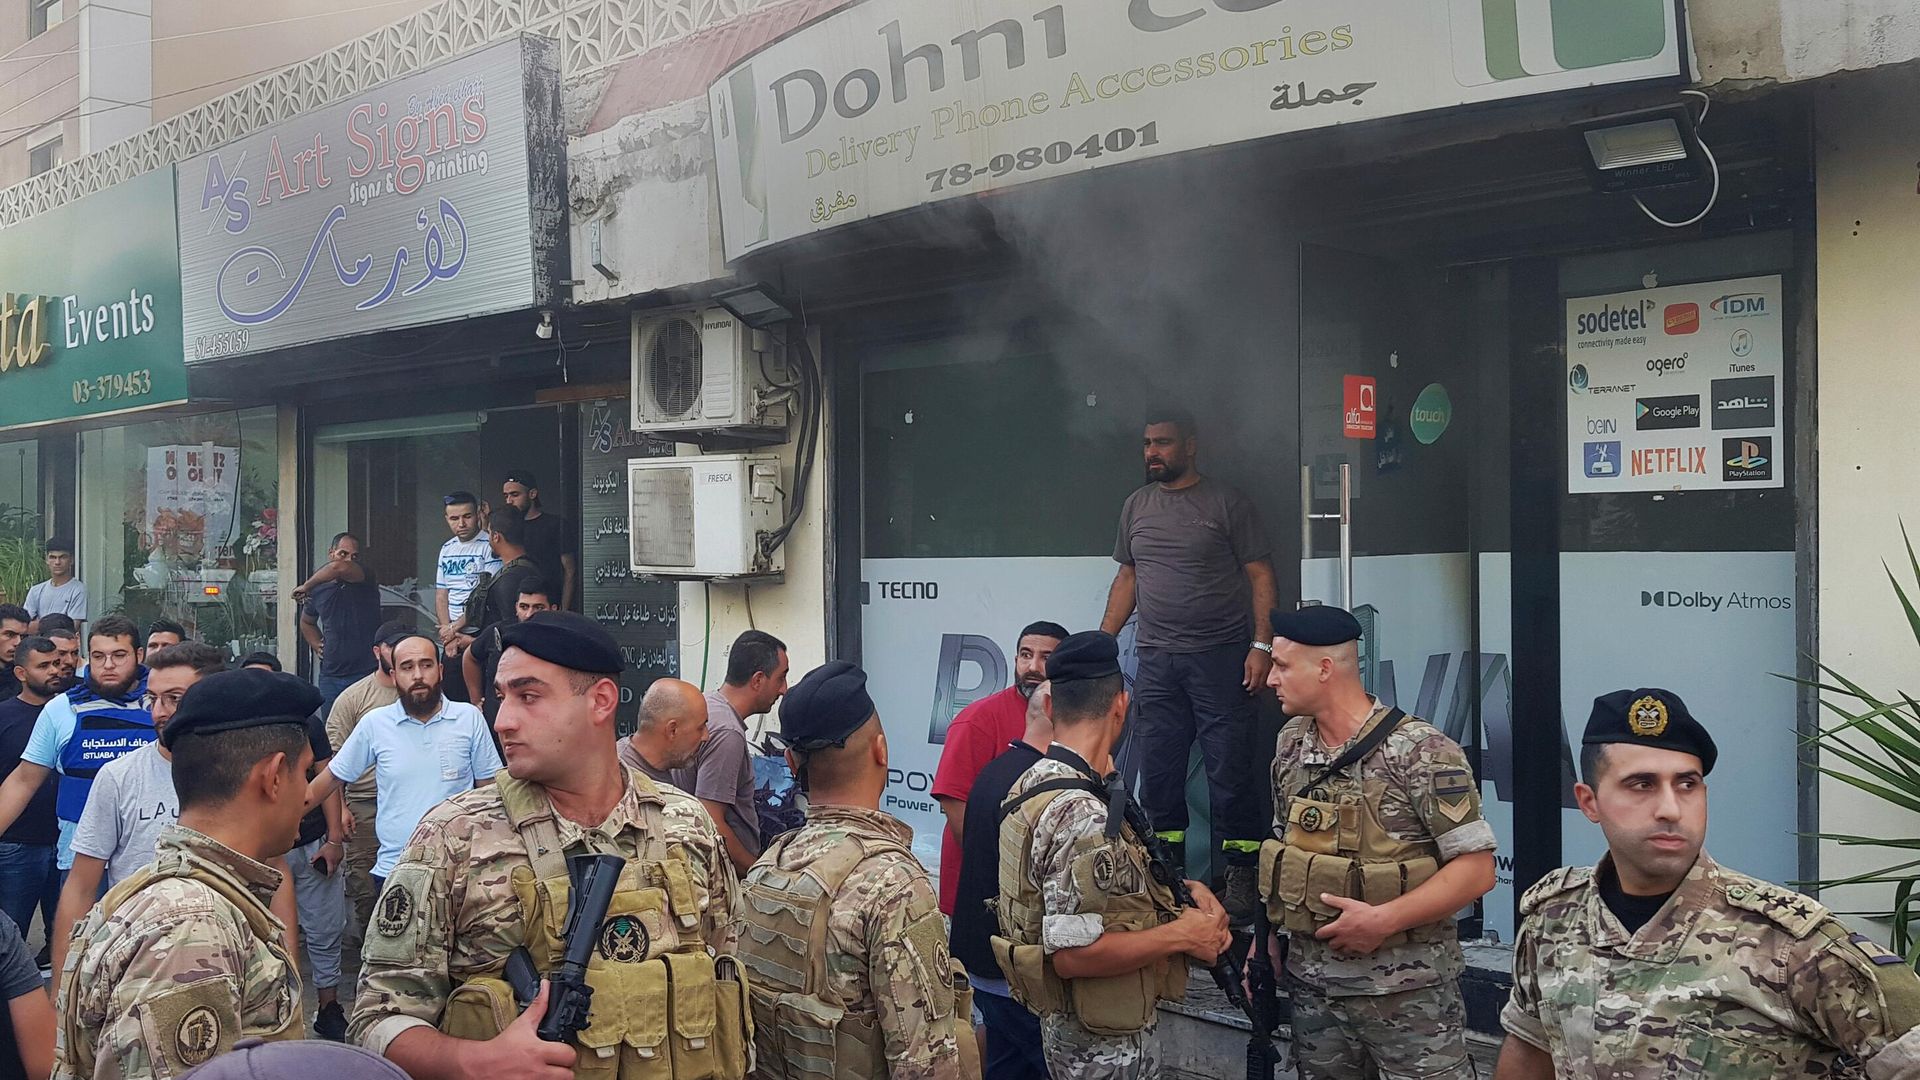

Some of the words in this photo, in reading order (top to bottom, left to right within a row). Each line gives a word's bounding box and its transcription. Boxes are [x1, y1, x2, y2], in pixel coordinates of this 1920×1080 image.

[805, 124, 921, 179] Delivery
[931, 90, 1051, 141] Phone
[1059, 23, 1354, 109] Accessories
[1269, 80, 1378, 112] جملة
[256, 134, 332, 206] Art
[346, 95, 487, 195] Signs
[925, 120, 1160, 193] 78-980401
[349, 176, 382, 206] Signs
[426, 150, 489, 184] Printing
[809, 190, 858, 223] مفرق
[62, 287, 155, 349] Events
[704, 320, 732, 331] HYUNDAI
[1577, 299, 1647, 335] sodetel
[1577, 339, 1614, 349] connectivity
[1615, 336, 1632, 346] made
[1632, 335, 1647, 346] easy
[1729, 363, 1756, 373] iTunes
[72, 368, 152, 404] 03-379453
[1588, 383, 1637, 395] TERRANET
[1652, 405, 1682, 419] Google
[1682, 404, 1700, 417] Play
[1717, 396, 1768, 410] شاهد
[1415, 407, 1445, 423] touch
[1631, 446, 1707, 477] NETFLIX
[707, 472, 733, 483] FRESCA
[1728, 469, 1766, 477] PlayStation
[877, 581, 939, 600] TECNO
[1667, 590, 1723, 612] Dolby
[1726, 592, 1792, 610] Atmos
[886, 795, 934, 813] Power
